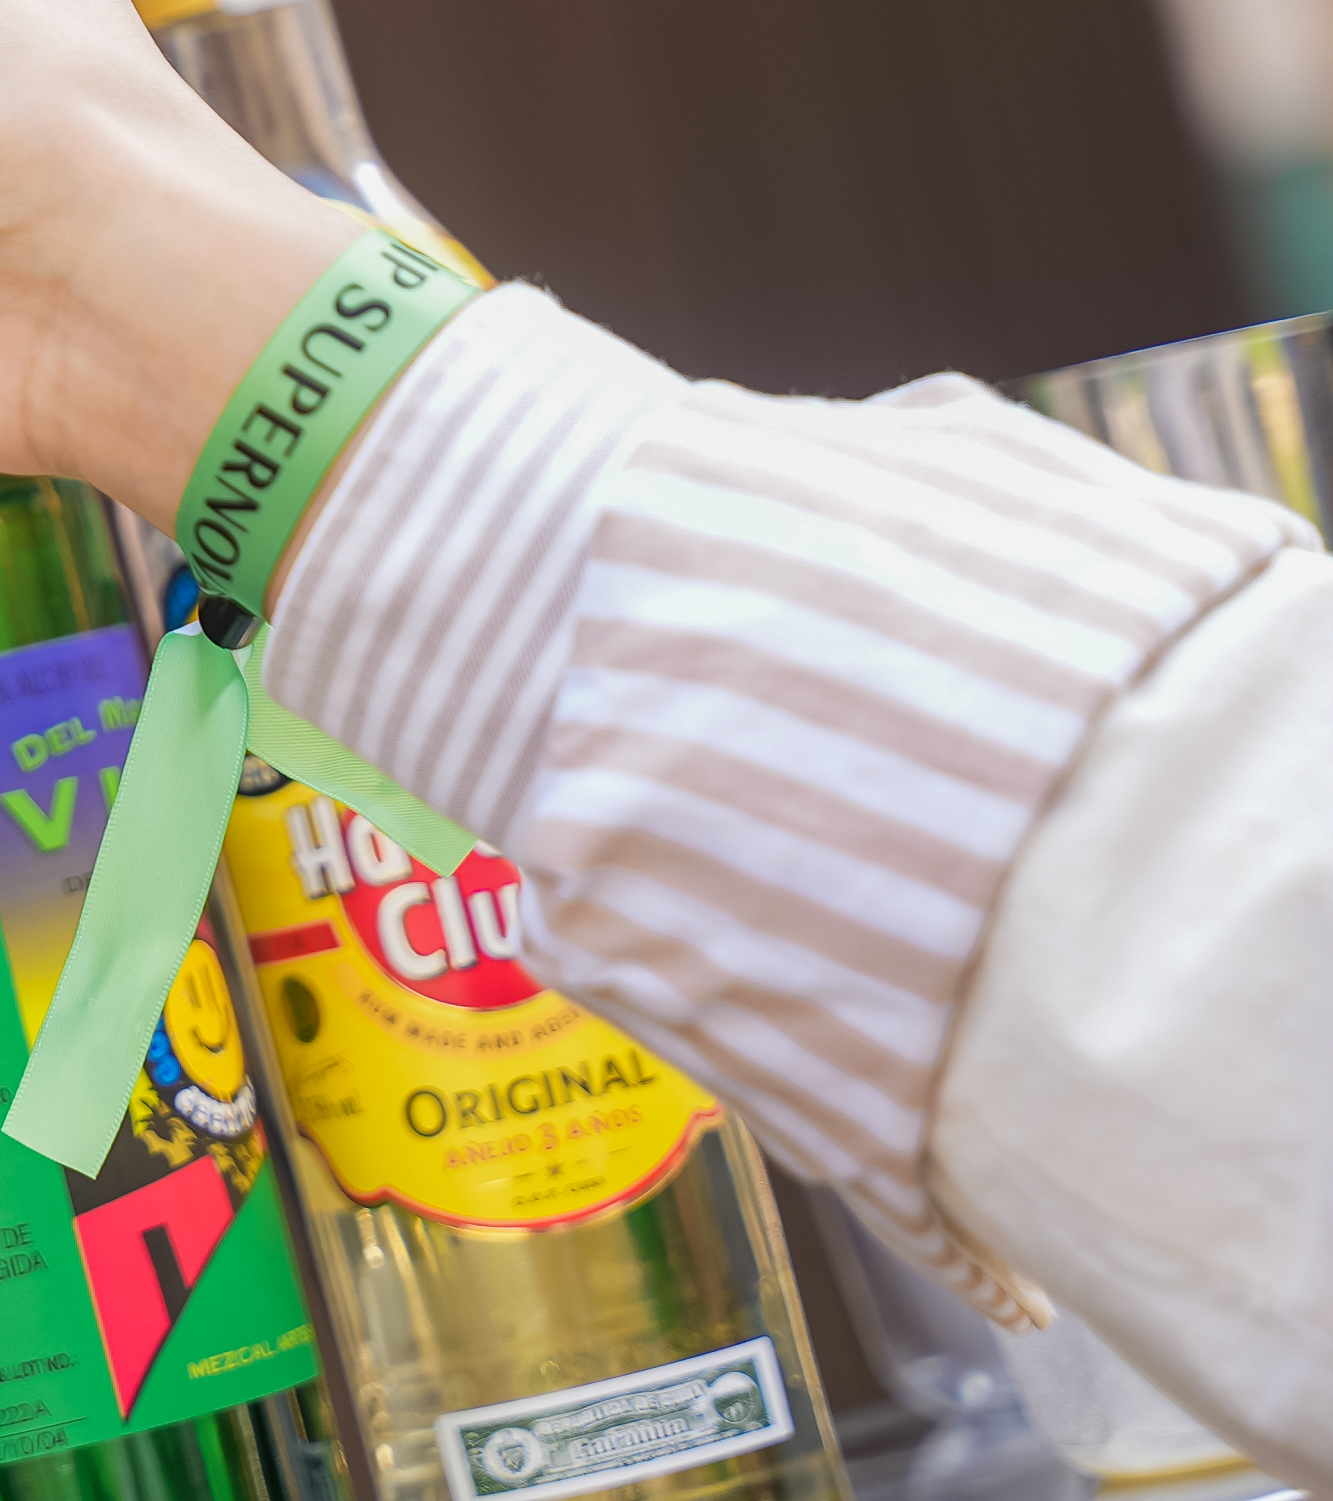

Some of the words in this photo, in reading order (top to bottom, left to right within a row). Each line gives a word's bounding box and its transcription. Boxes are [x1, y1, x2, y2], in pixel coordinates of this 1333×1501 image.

[380, 241, 440, 290] IP
[190, 282, 393, 586] SUPERNOV
[11, 717, 98, 773] DEL
[376, 876, 521, 981] Clu
[477, 1029, 523, 1052] AND
[404, 1048, 657, 1138] ORIGINAL
[444, 1132, 533, 1171] AÑEJO
[536, 1120, 559, 1151] 3
[565, 1104, 643, 1141] AÑOS
[0, 1222, 34, 1250] DE
[13, 1360, 43, 1380] LOT
[187, 1340, 276, 1380] MEZCAL
